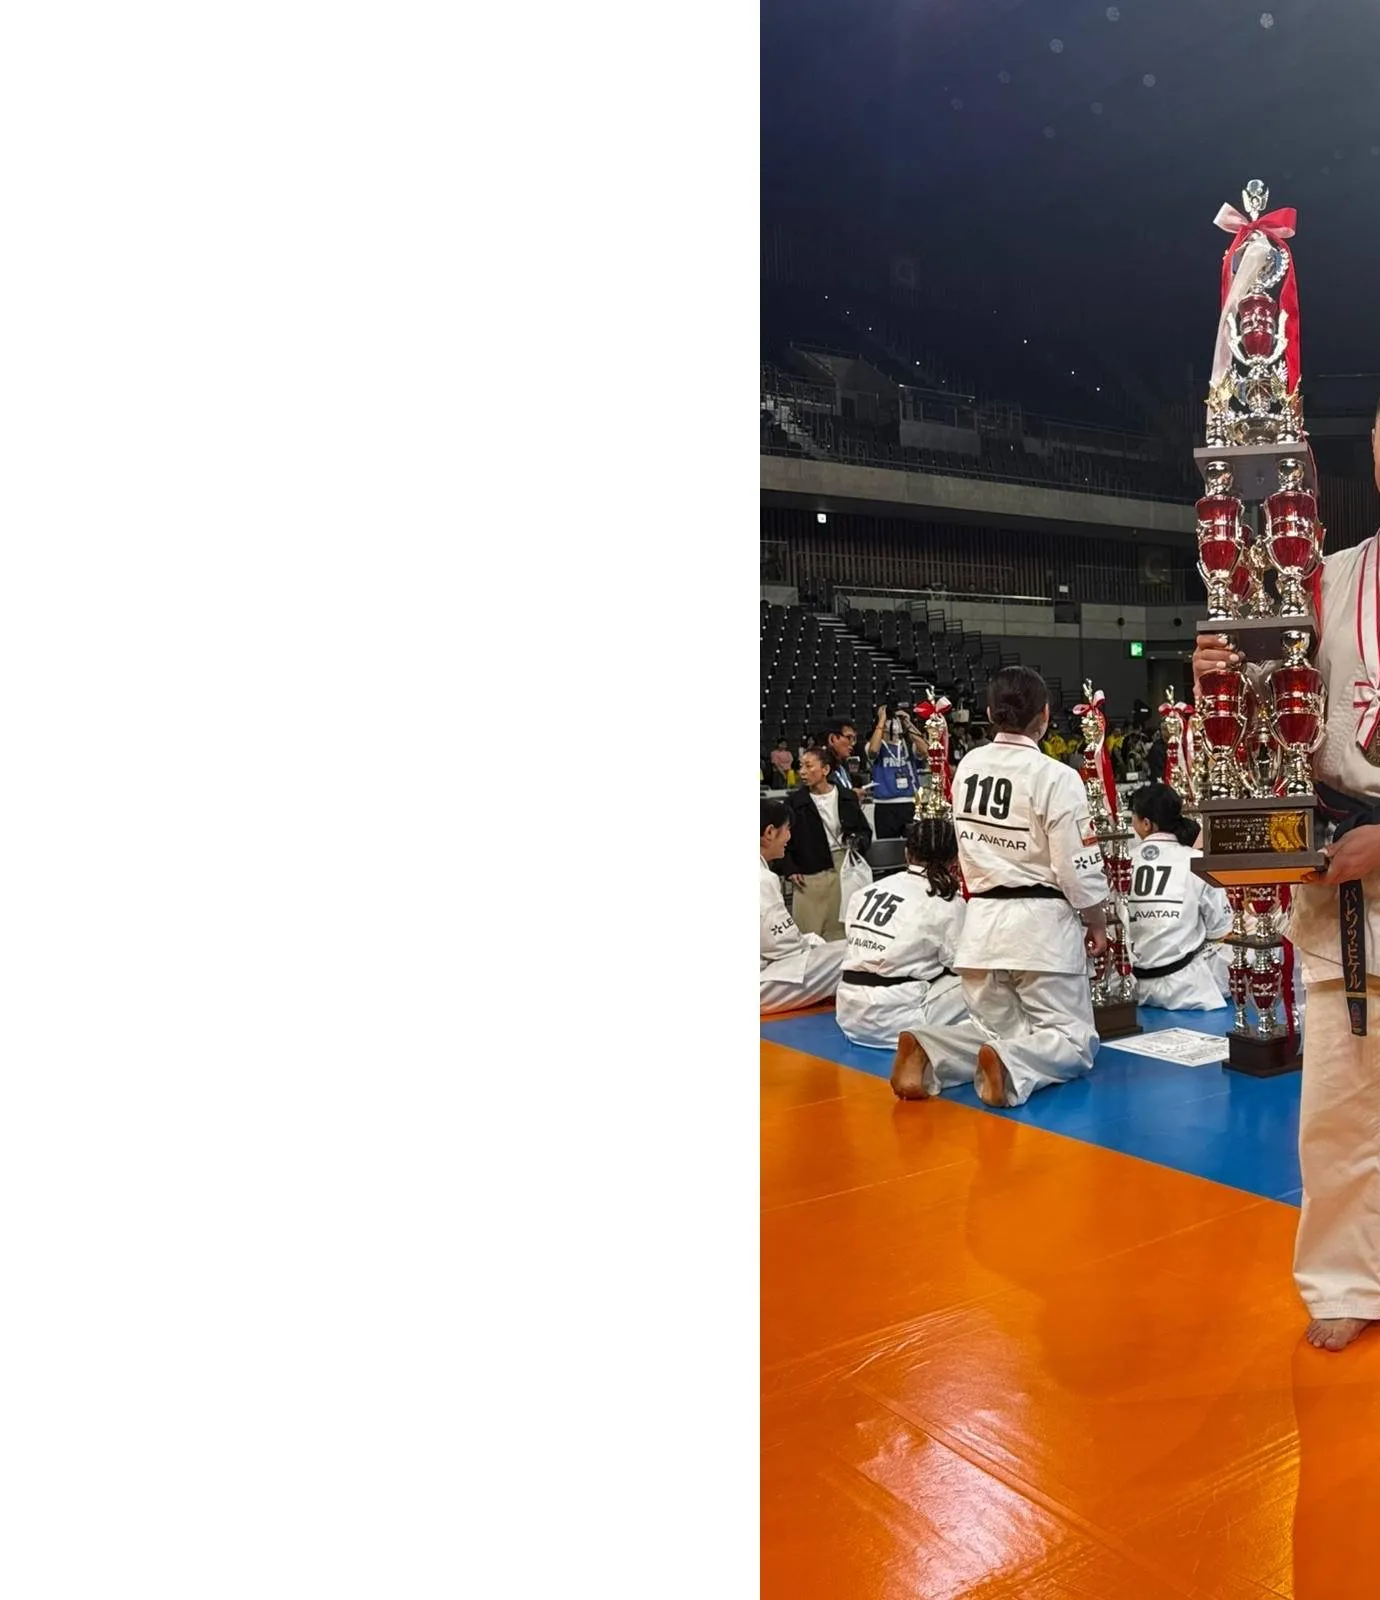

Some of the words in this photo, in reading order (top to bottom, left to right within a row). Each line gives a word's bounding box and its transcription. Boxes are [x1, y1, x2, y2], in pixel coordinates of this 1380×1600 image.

[962, 773, 1013, 820] 119
[959, 830, 974, 841] AI
[977, 833, 1027, 851] AVATAR
[1128, 864, 1172, 897] 07
[856, 887, 905, 927] 115
[1134, 910, 1180, 919] AVATAR
